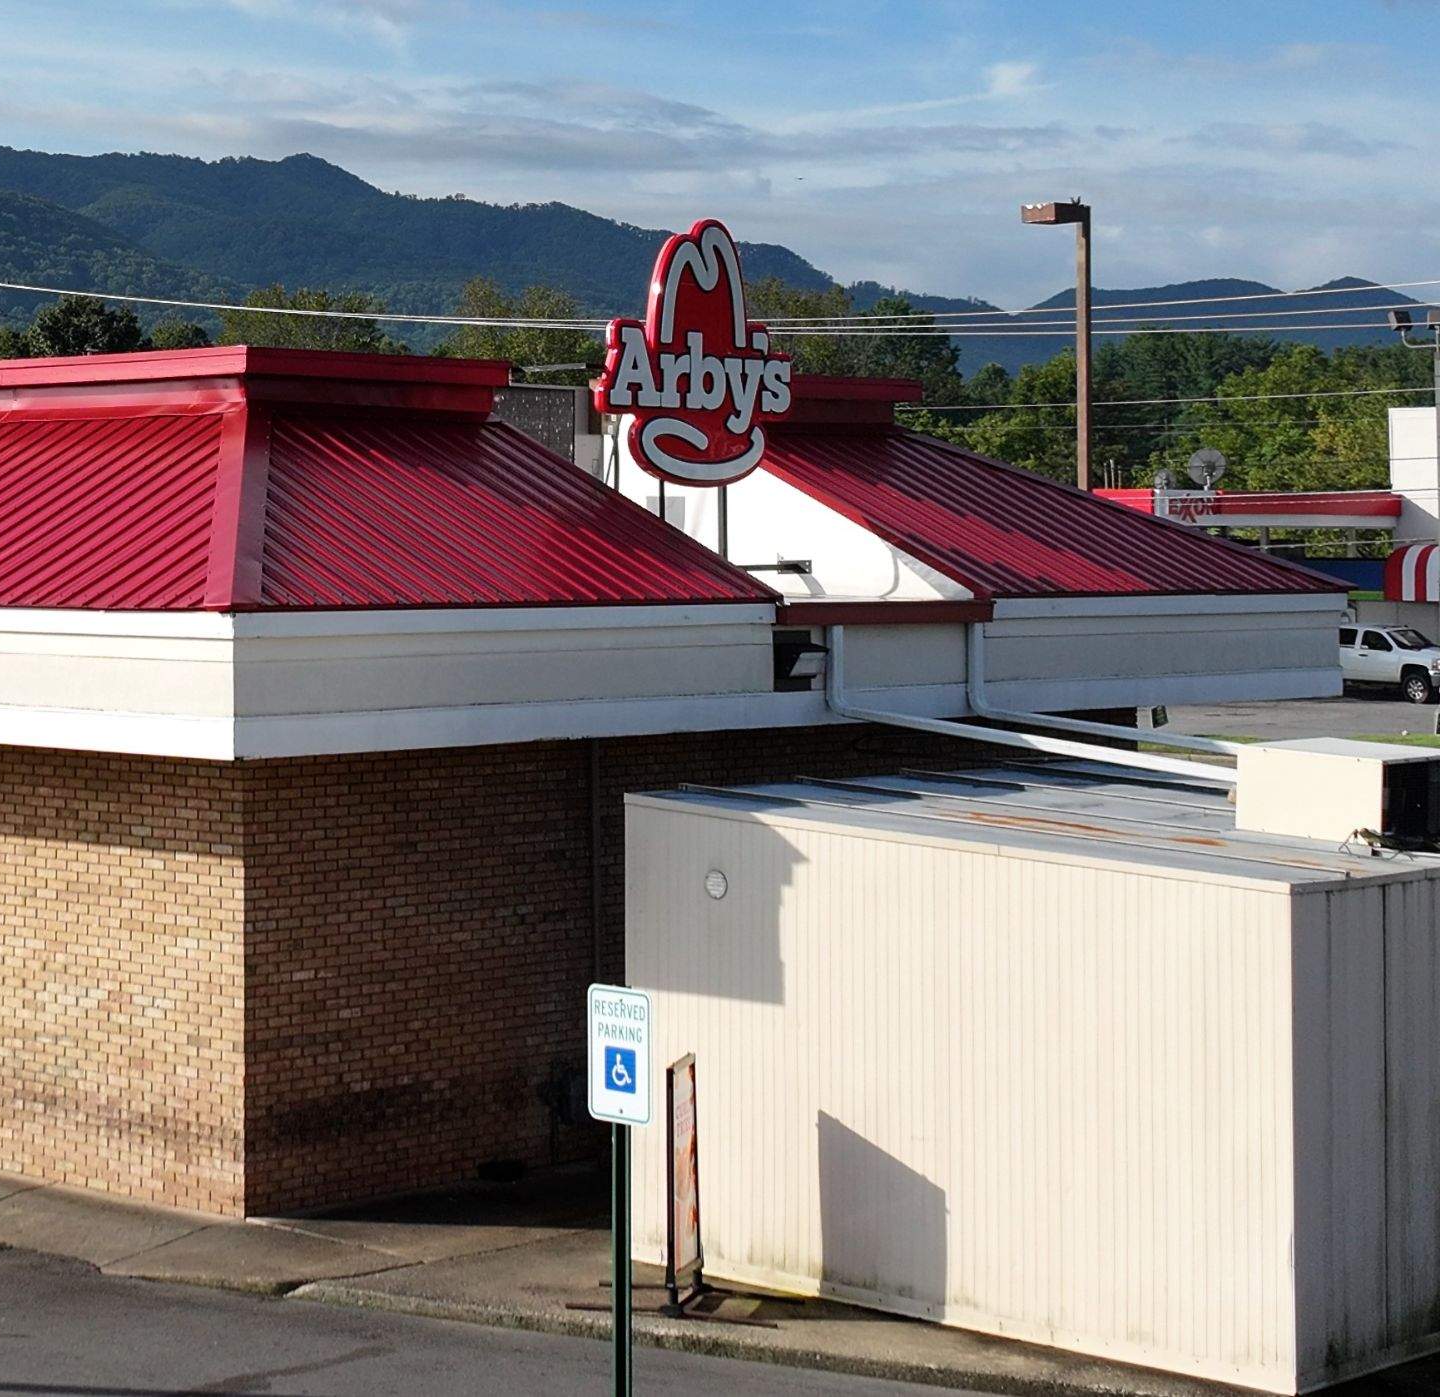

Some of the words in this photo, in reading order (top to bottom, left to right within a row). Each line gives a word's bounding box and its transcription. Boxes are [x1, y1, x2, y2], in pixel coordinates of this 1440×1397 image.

[610, 327, 791, 434] Arby's
[594, 1000, 646, 1021] RESERVED
[598, 1022, 643, 1043] PARKING
